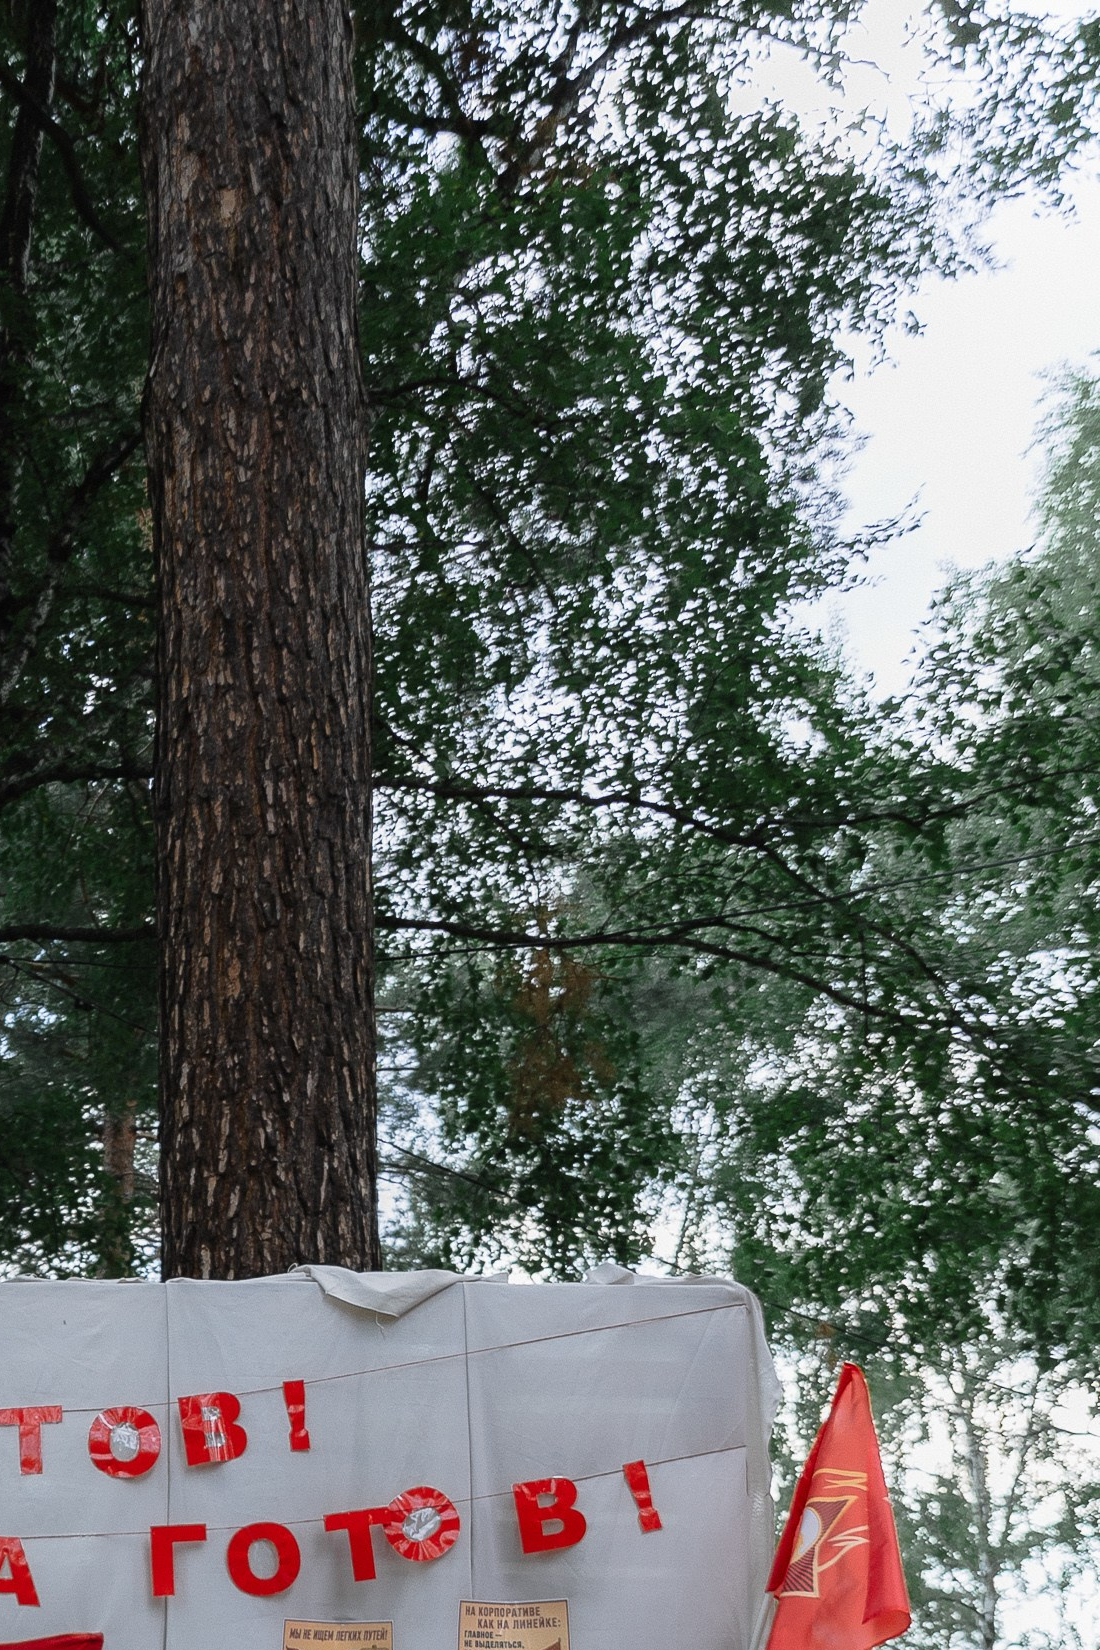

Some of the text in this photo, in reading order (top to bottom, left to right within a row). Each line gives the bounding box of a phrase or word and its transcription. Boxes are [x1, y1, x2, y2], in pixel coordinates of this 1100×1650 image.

[465, 1605, 540, 1617] НА КОРПОРАТИВЕ
[477, 1616, 561, 1629] КАК НА ЛИНЕЙКЕ:
[289, 1627, 388, 1641] МЫ НЕ ИЩЕМ ЛЕГКИХ ПУТЕЙ!
[464, 1630, 494, 1639] ГЛАВНОЕ
[464, 1640, 525, 1649] НЕ ВЫДЕЛЯТЬСЯ,
